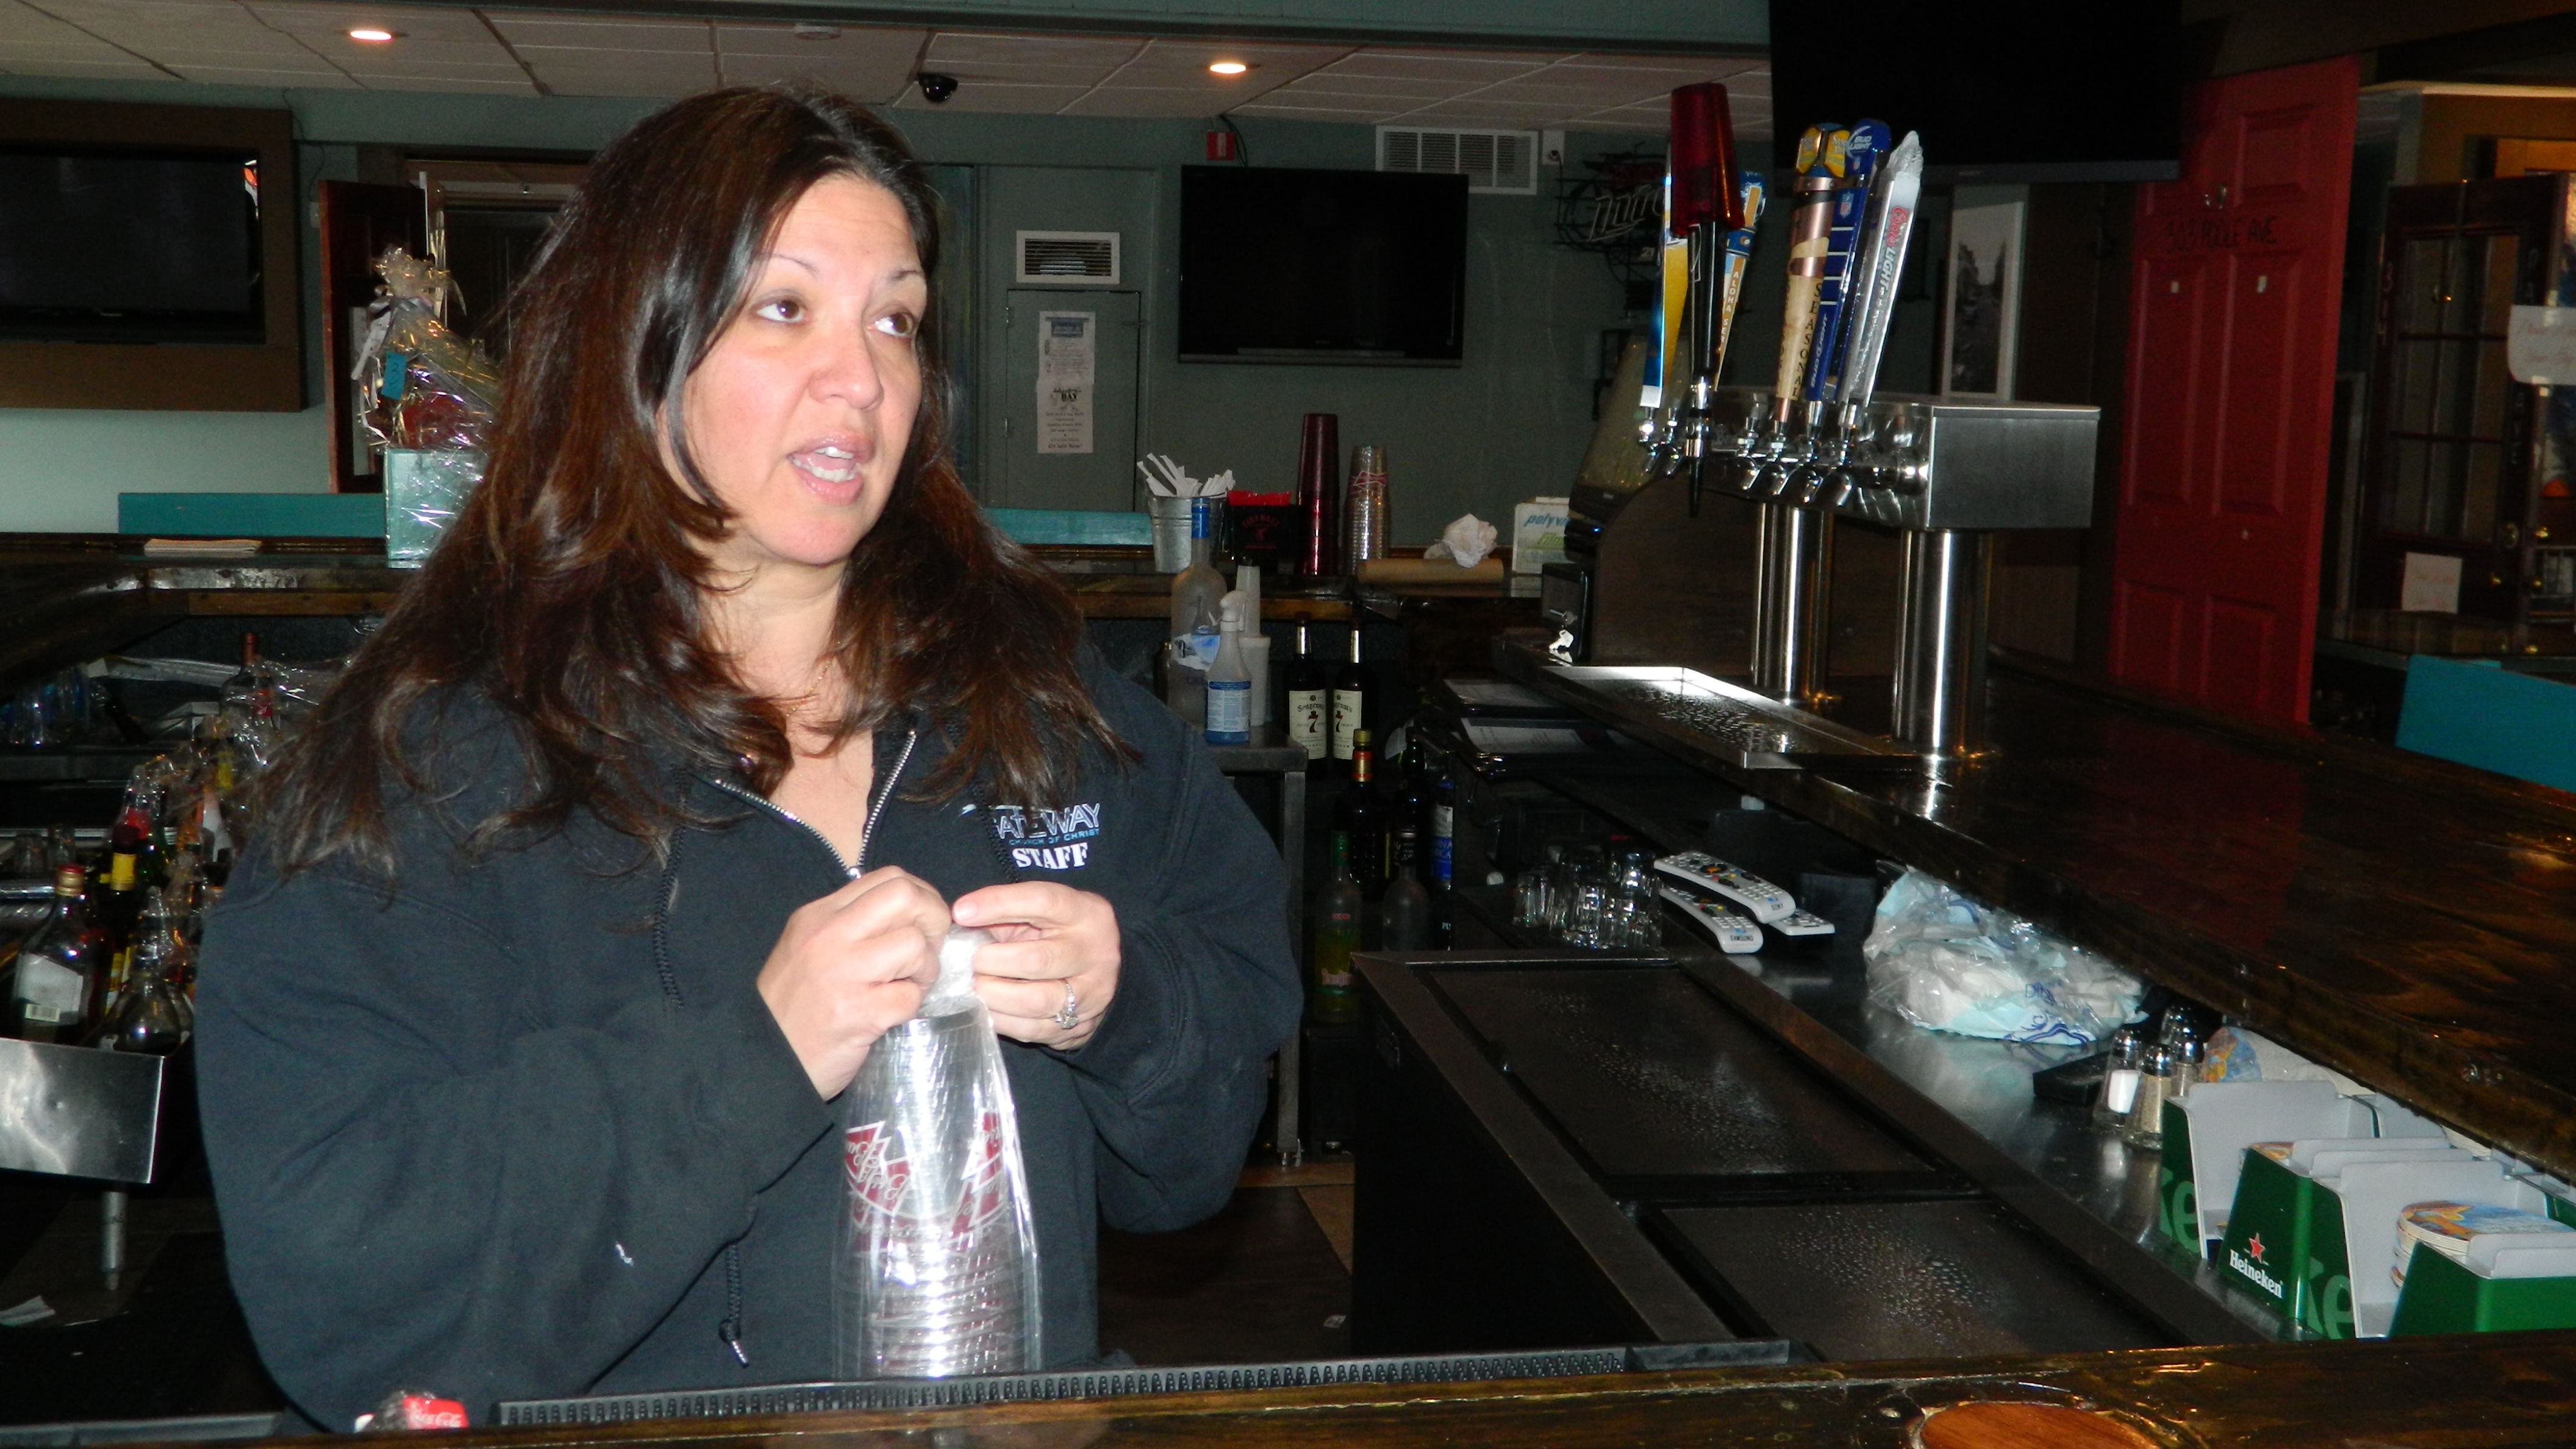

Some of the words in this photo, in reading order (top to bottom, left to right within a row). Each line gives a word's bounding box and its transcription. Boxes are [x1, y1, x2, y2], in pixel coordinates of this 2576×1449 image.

[1886, 206, 1908, 246] Coors
[1880, 247, 1896, 291] LIGHT
[1725, 271, 1739, 312] ALOHA
[1792, 282, 1822, 397] SEASONAL
[1308, 714, 1318, 733] 7
[993, 803, 1100, 839] ATEWAY
[1064, 828, 1100, 841] CHRIST
[1012, 842, 1088, 869] STAFF
[2230, 1249, 2283, 1298] Heineken
